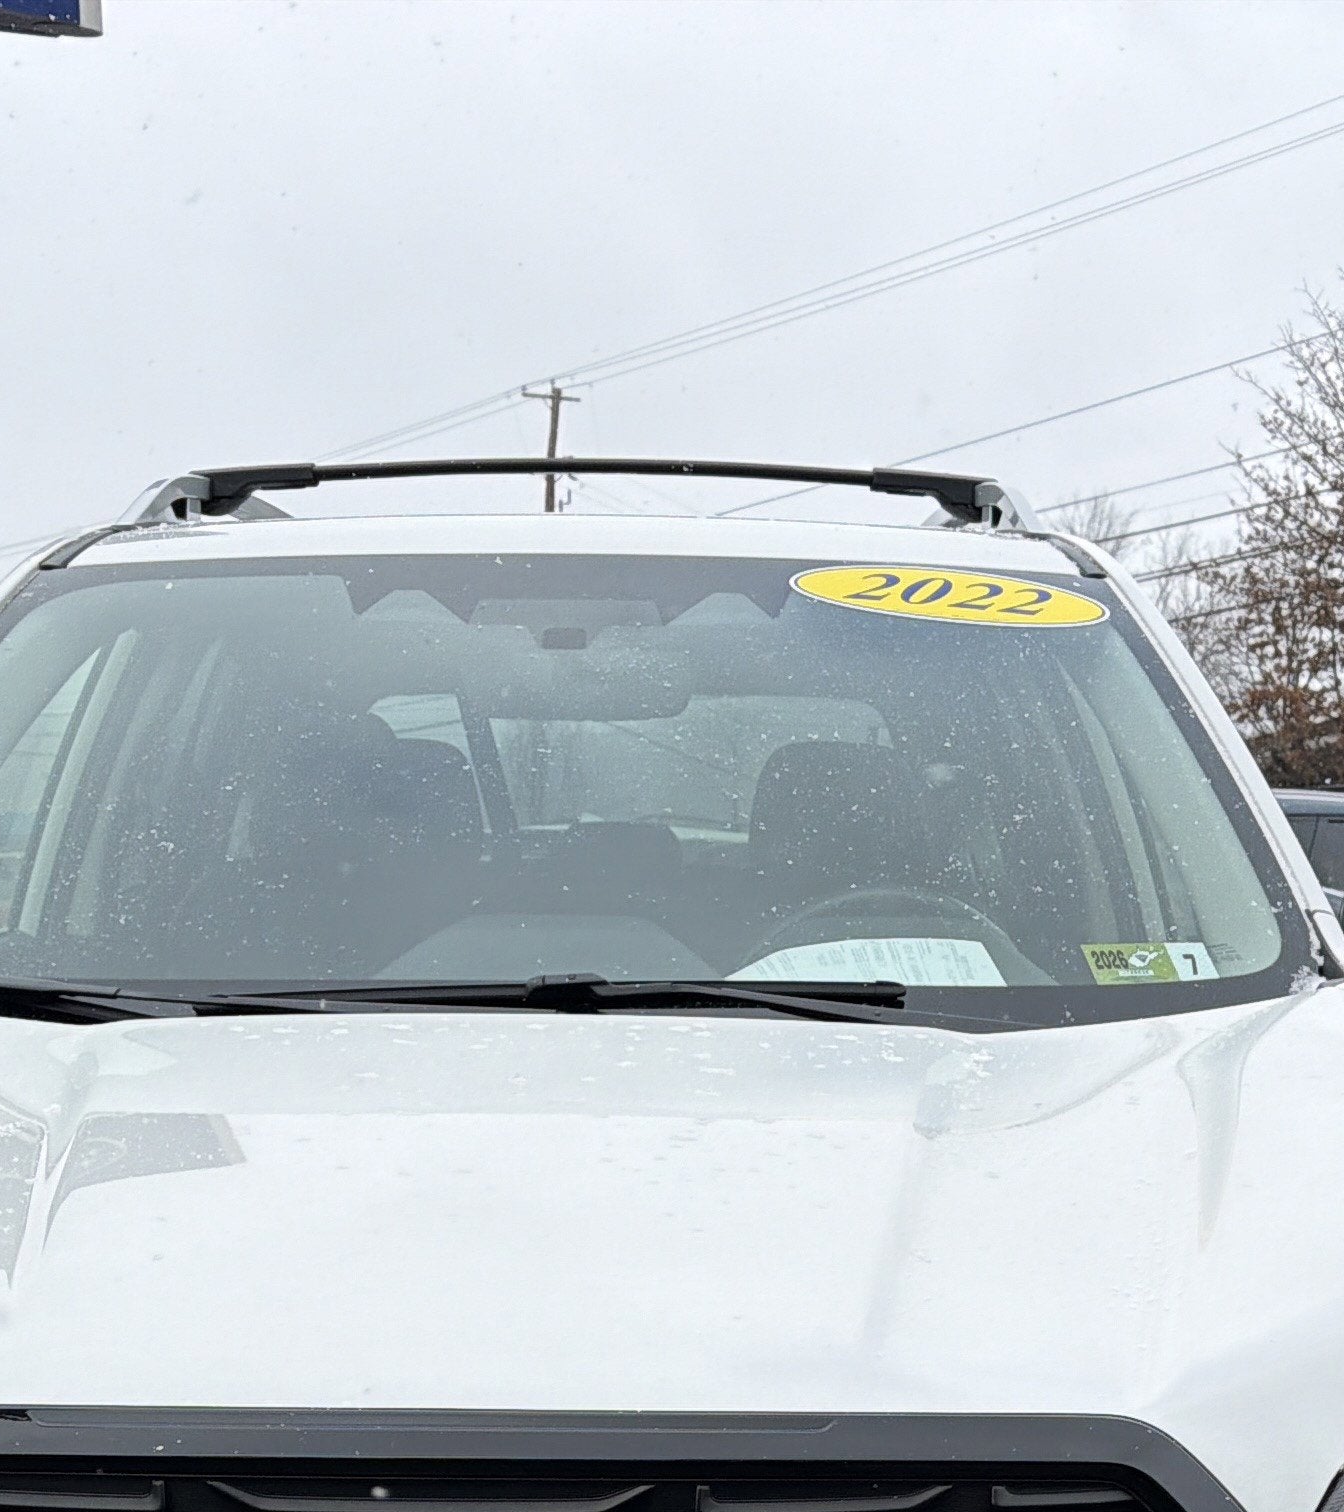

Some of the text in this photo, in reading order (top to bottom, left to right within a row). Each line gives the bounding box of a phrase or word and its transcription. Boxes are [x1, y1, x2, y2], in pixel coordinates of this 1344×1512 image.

[842, 573, 1053, 616] 2022
[1090, 950, 1198, 975] 2026 7
